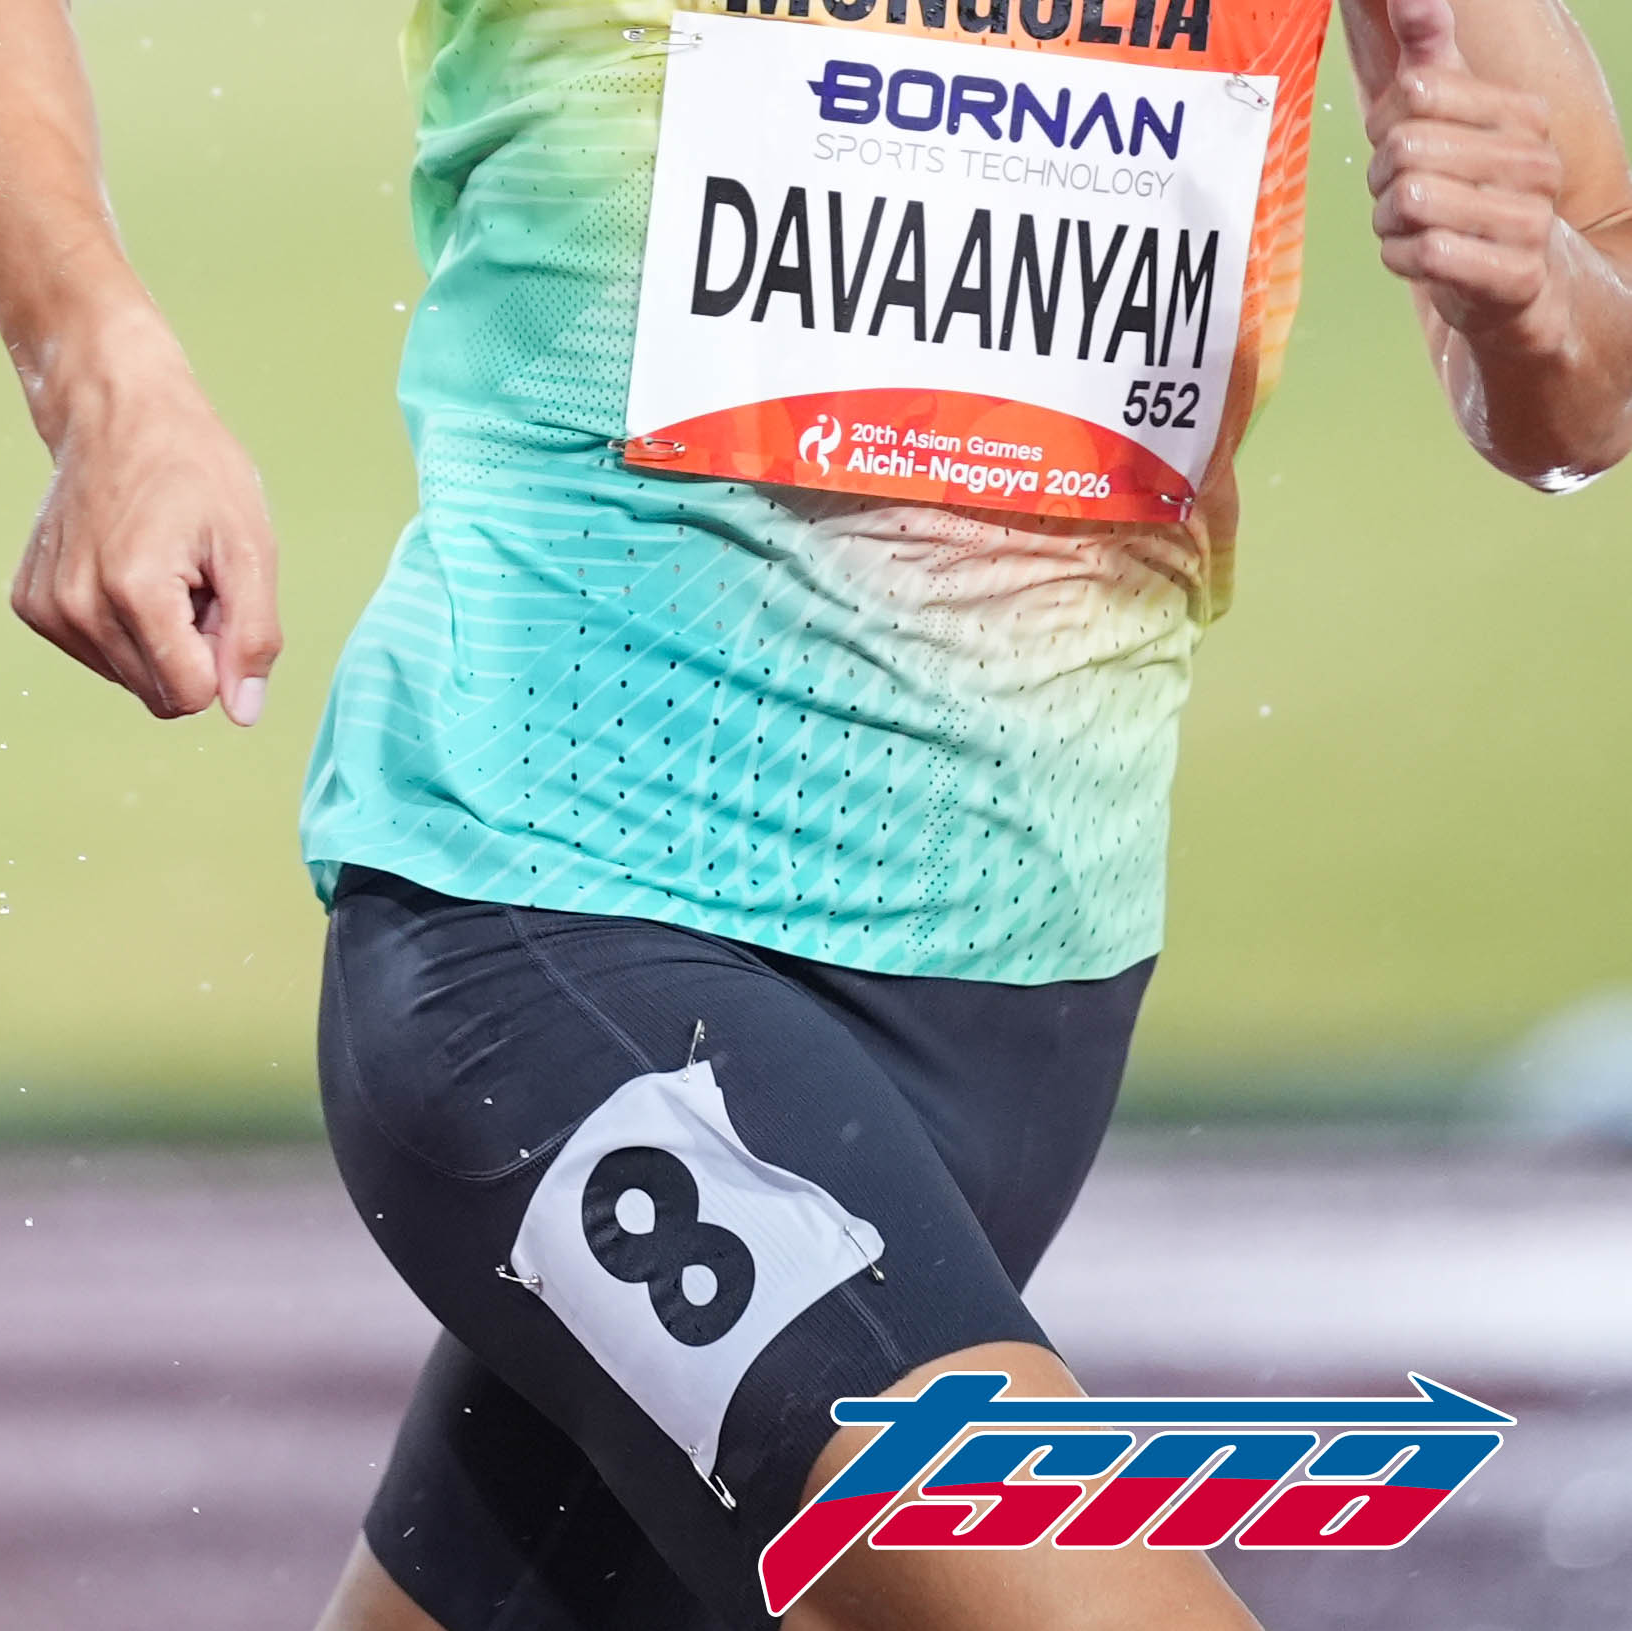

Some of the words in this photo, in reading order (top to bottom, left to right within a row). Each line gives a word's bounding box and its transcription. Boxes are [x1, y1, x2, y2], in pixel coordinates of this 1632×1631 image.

[806, 59, 1185, 160] BORNAN
[813, 133, 945, 173] SPORTS
[960, 149, 1175, 199] TECHNOLOGY
[691, 176, 1219, 369] DAVAANYAM
[1122, 380, 1201, 429] 552
[846, 447, 1039, 496] Aichi-Nagoya
[1044, 469, 1112, 499] 2026
[850, 423, 897, 446] 20th
[902, 428, 961, 453] Asian
[967, 436, 1043, 463] Games
[582, 1146, 756, 1348] 8
